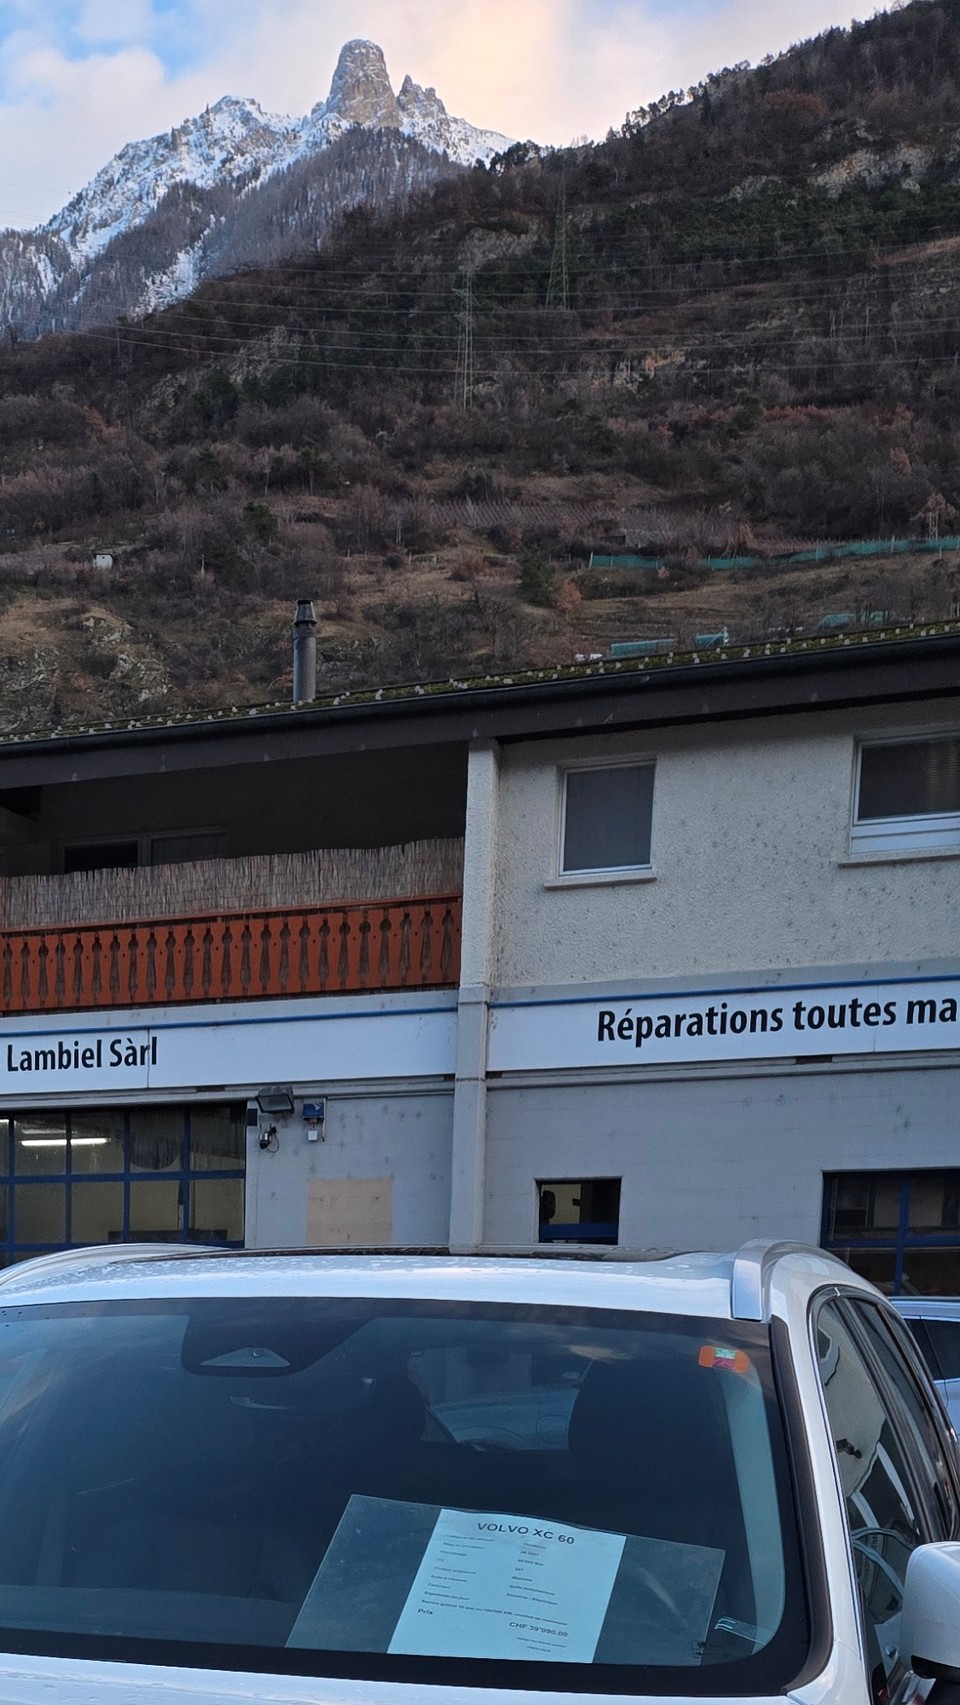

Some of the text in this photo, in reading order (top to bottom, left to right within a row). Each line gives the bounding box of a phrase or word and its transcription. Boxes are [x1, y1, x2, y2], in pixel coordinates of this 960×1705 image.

[597, 1002, 783, 1048] Réparations
[792, 998, 897, 1031] toutes
[6, 1040, 102, 1072] Lambiel
[109, 1036, 158, 1067] Sàrl
[477, 1522, 575, 1545] VOLVO XC 60
[509, 1621, 528, 1629] CHF
